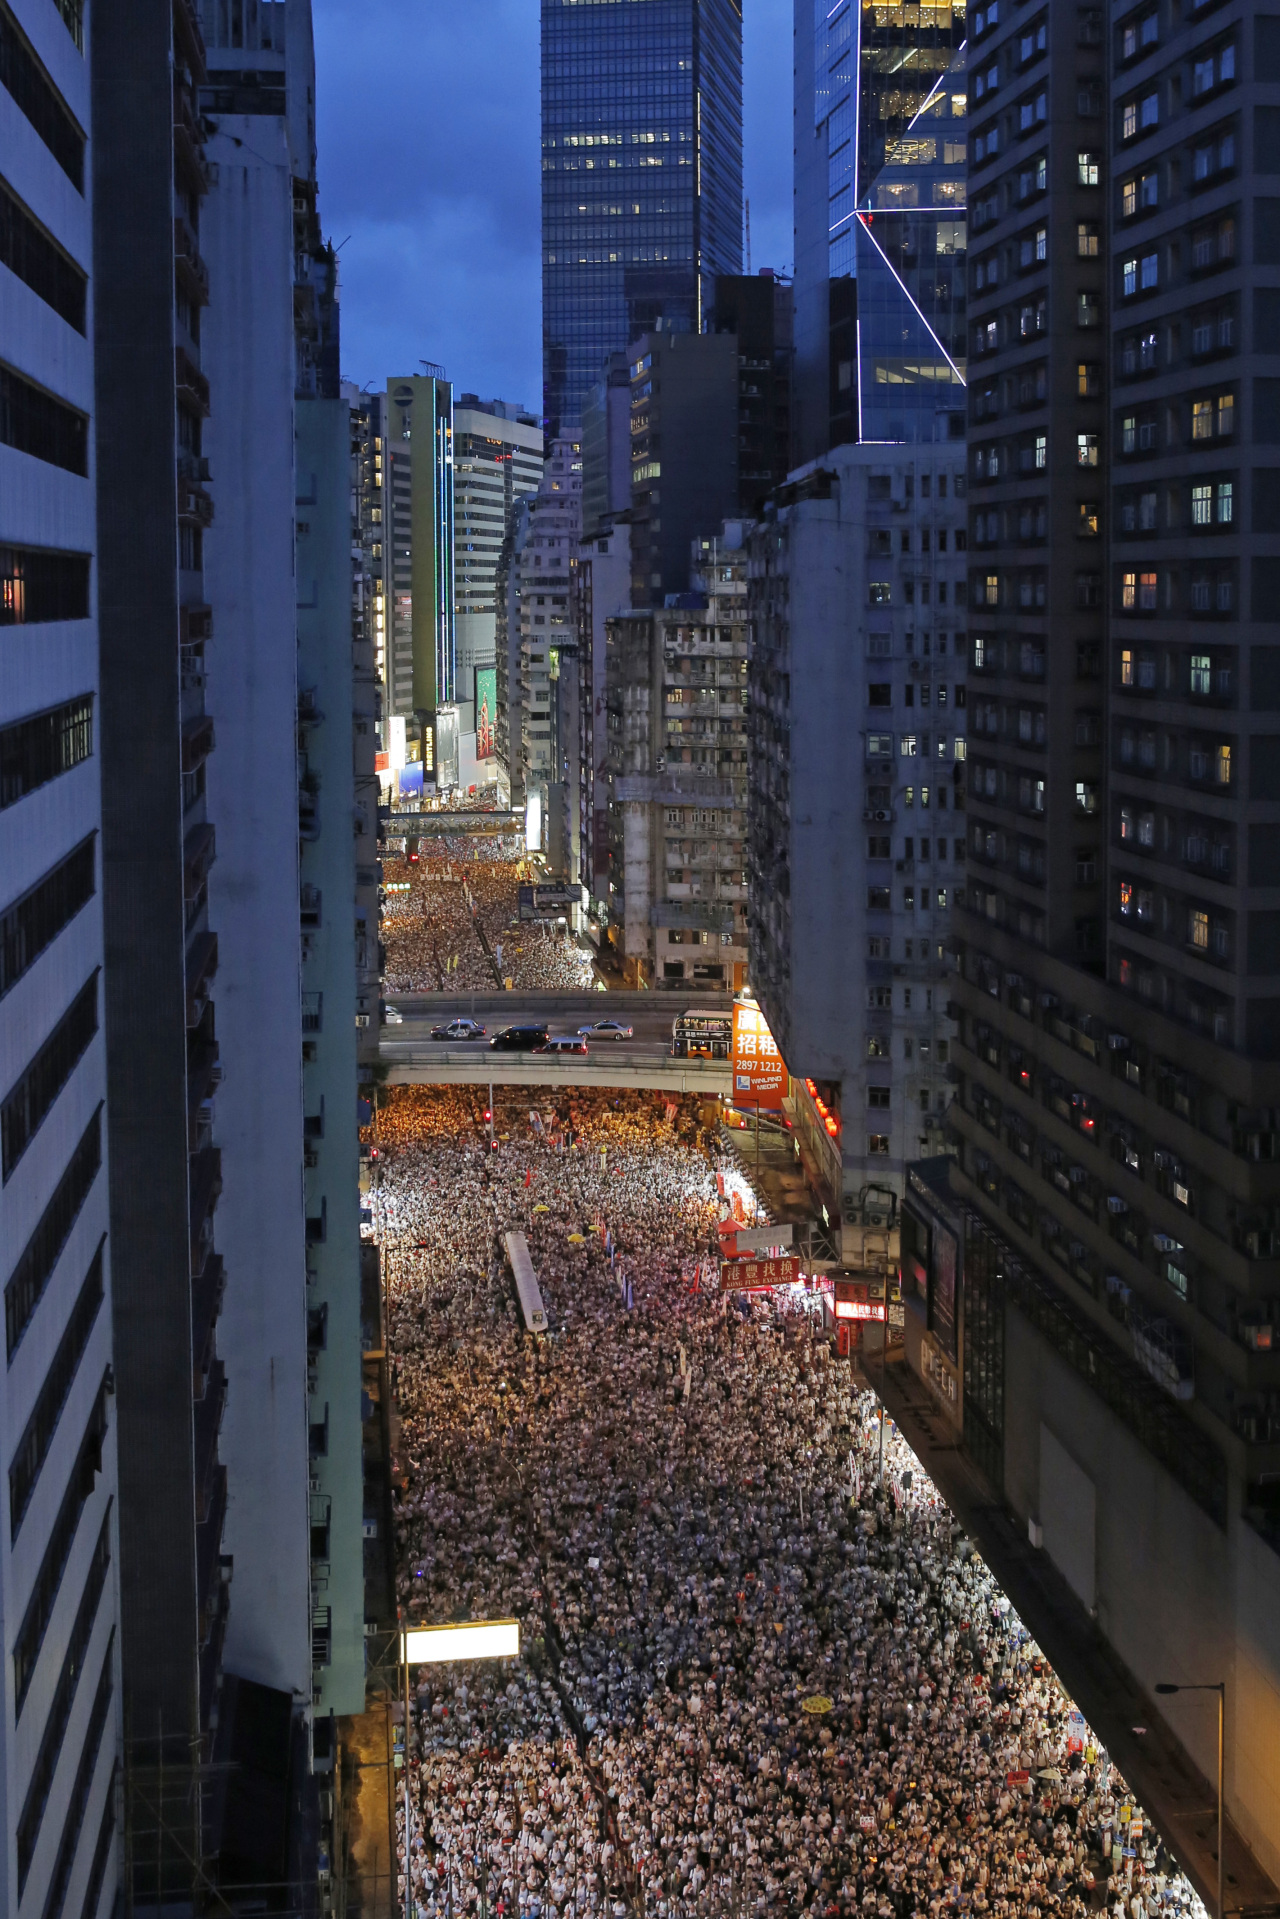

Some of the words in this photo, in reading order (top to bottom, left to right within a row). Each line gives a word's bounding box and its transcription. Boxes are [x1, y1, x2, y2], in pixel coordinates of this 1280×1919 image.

[425, 726, 433, 771] BREITLING
[737, 1033, 778, 1056] 招租
[736, 1059, 758, 1071] 2897
[760, 1061, 782, 1073] 1212
[750, 1075, 782, 1084] WINLAND
[756, 1083, 778, 1091] MEDIA
[727, 1260, 793, 1281] 港豐找換
[726, 1280, 743, 1288] KONG
[745, 1278, 761, 1286] FUNG
[762, 1275, 793, 1285] EXCHANGE
